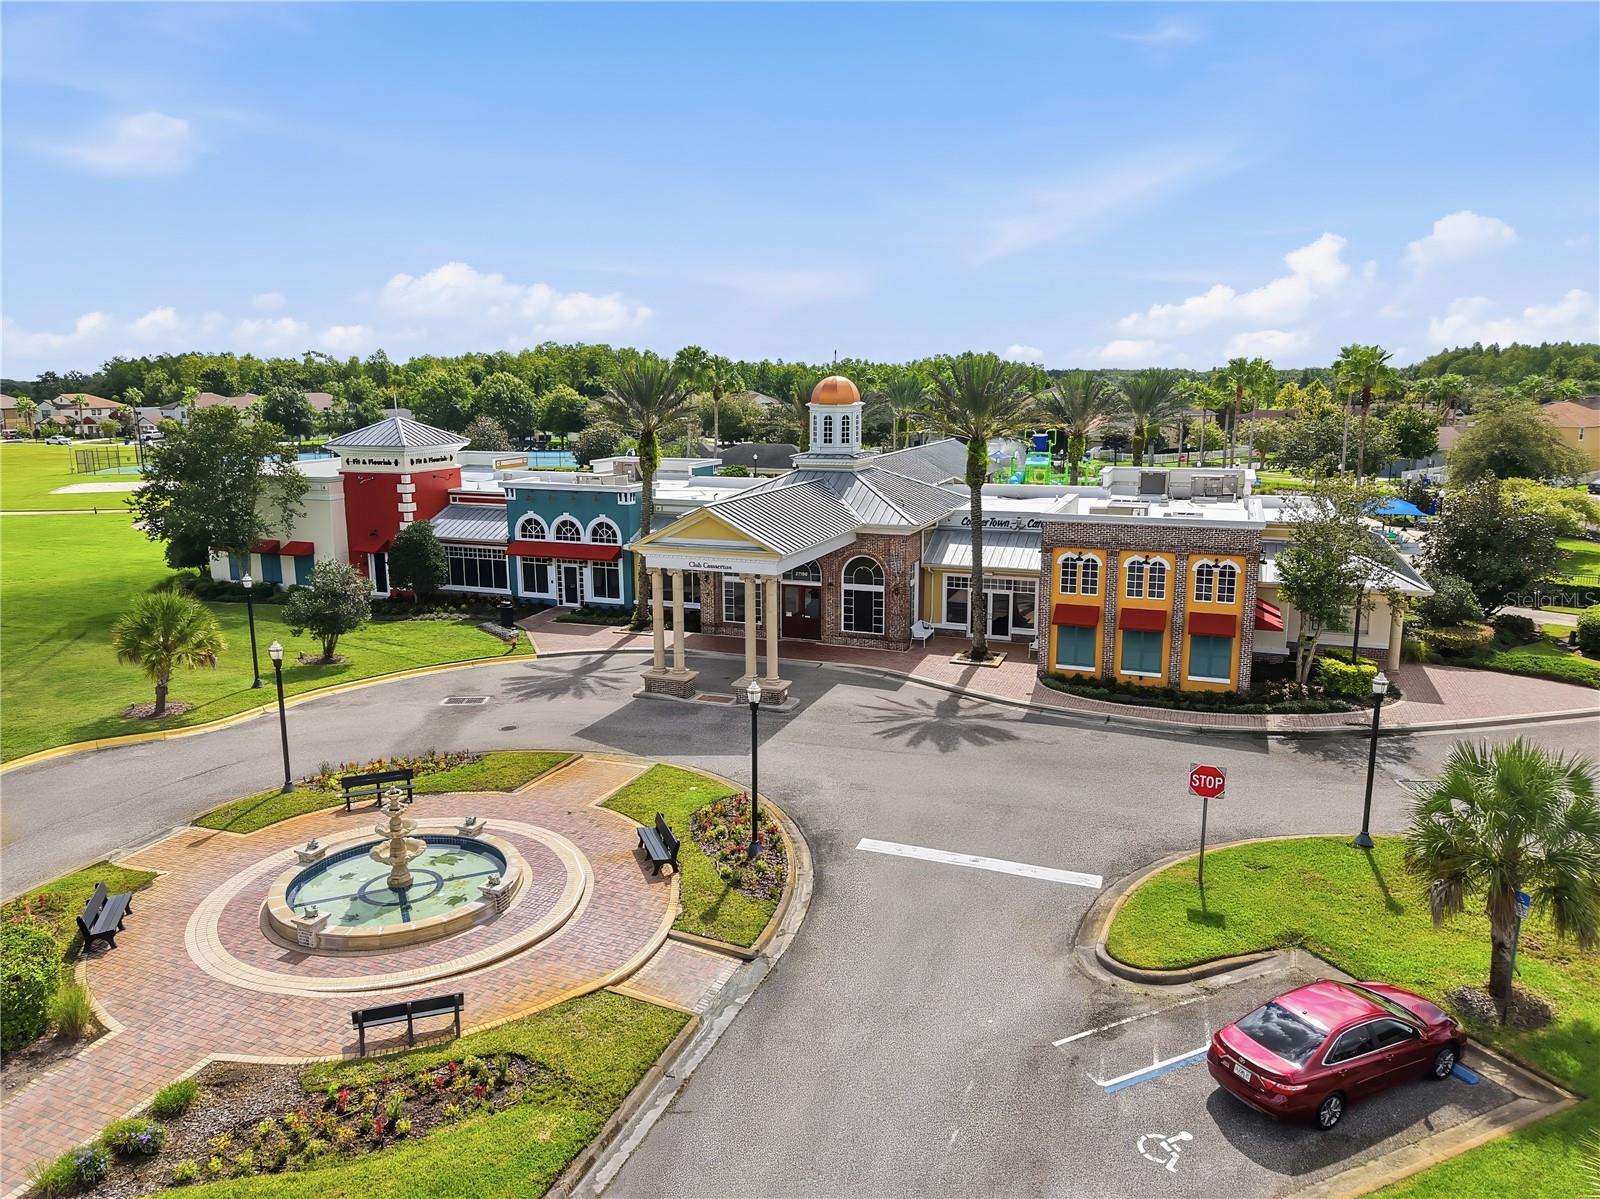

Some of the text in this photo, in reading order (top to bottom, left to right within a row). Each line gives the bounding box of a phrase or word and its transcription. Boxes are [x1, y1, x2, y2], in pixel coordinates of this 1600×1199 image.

[428, 455, 448, 463] Flourish
[1027, 518, 1043, 528] Caf
[1191, 774, 1224, 789] STOP
